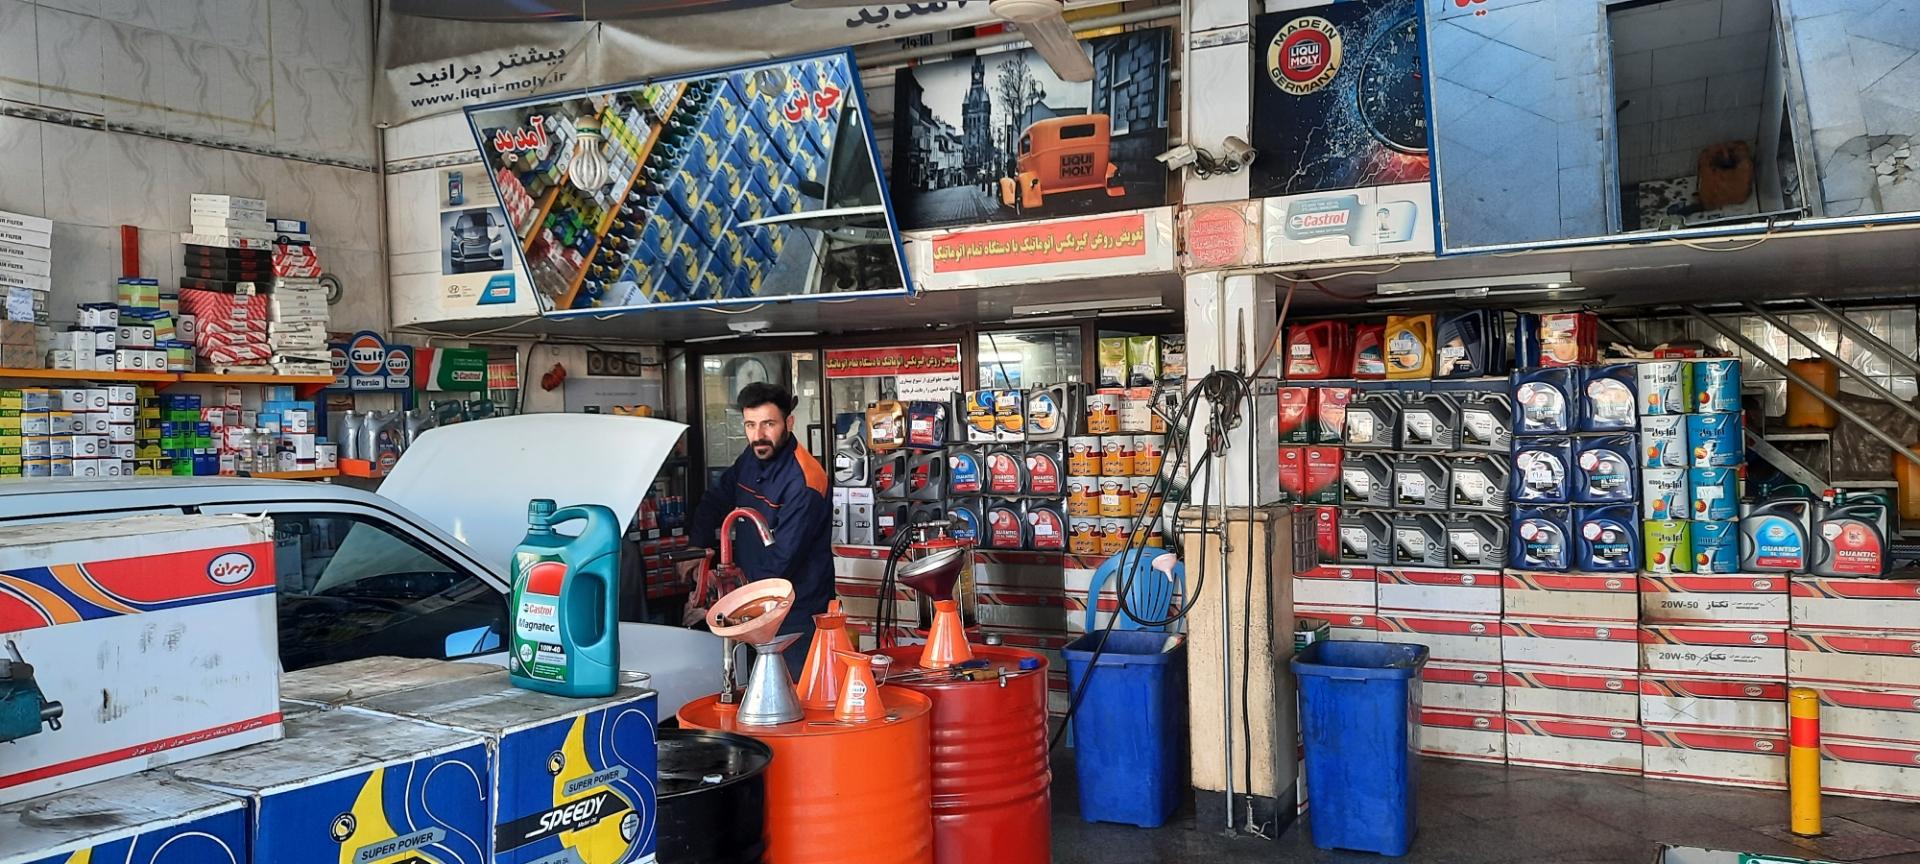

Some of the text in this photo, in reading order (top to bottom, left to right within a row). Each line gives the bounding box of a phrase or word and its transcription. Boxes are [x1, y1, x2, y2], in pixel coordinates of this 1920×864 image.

[1274, 19, 1337, 47] MADE IN
[1290, 44, 1318, 56] LIQUI
[1290, 54, 1319, 66] MOLY
[409, 47, 567, 87] بیشتر برانید
[1271, 63, 1337, 93] GERMANY
[411, 72, 568, 107] www.liqui-moly.ir
[494, 115, 547, 162] آمدید
[1062, 152, 1092, 166] LIQUI
[1062, 164, 1092, 178] MOLY
[1304, 213, 1344, 227] Castrol
[934, 226, 1144, 262] تعویض روغن گیربکس اتوماتیک با دستگاه تمام اتوماتیک
[351, 350, 384, 362] Gulf
[388, 360, 408, 368] Gulf
[356, 378, 380, 387] Persia
[214, 562, 249, 577] بهران
[530, 604, 552, 616] Castrol
[1661, 600, 1699, 609] 20W-50
[1706, 600, 1729, 610] تکتاز
[518, 618, 555, 632] Magnatec
[540, 644, 561, 653] 10W-40
[1659, 652, 1696, 661] 20W-50
[1702, 652, 1726, 662] تکتاز
[132, 746, 144, 756] تهران
[152, 741, 166, 752] ایران
[569, 770, 619, 791] SUPER POWER
[526, 794, 608, 838] SPEEDY
[578, 819, 590, 828] Motor
[361, 832, 433, 861] SUPER POWER
